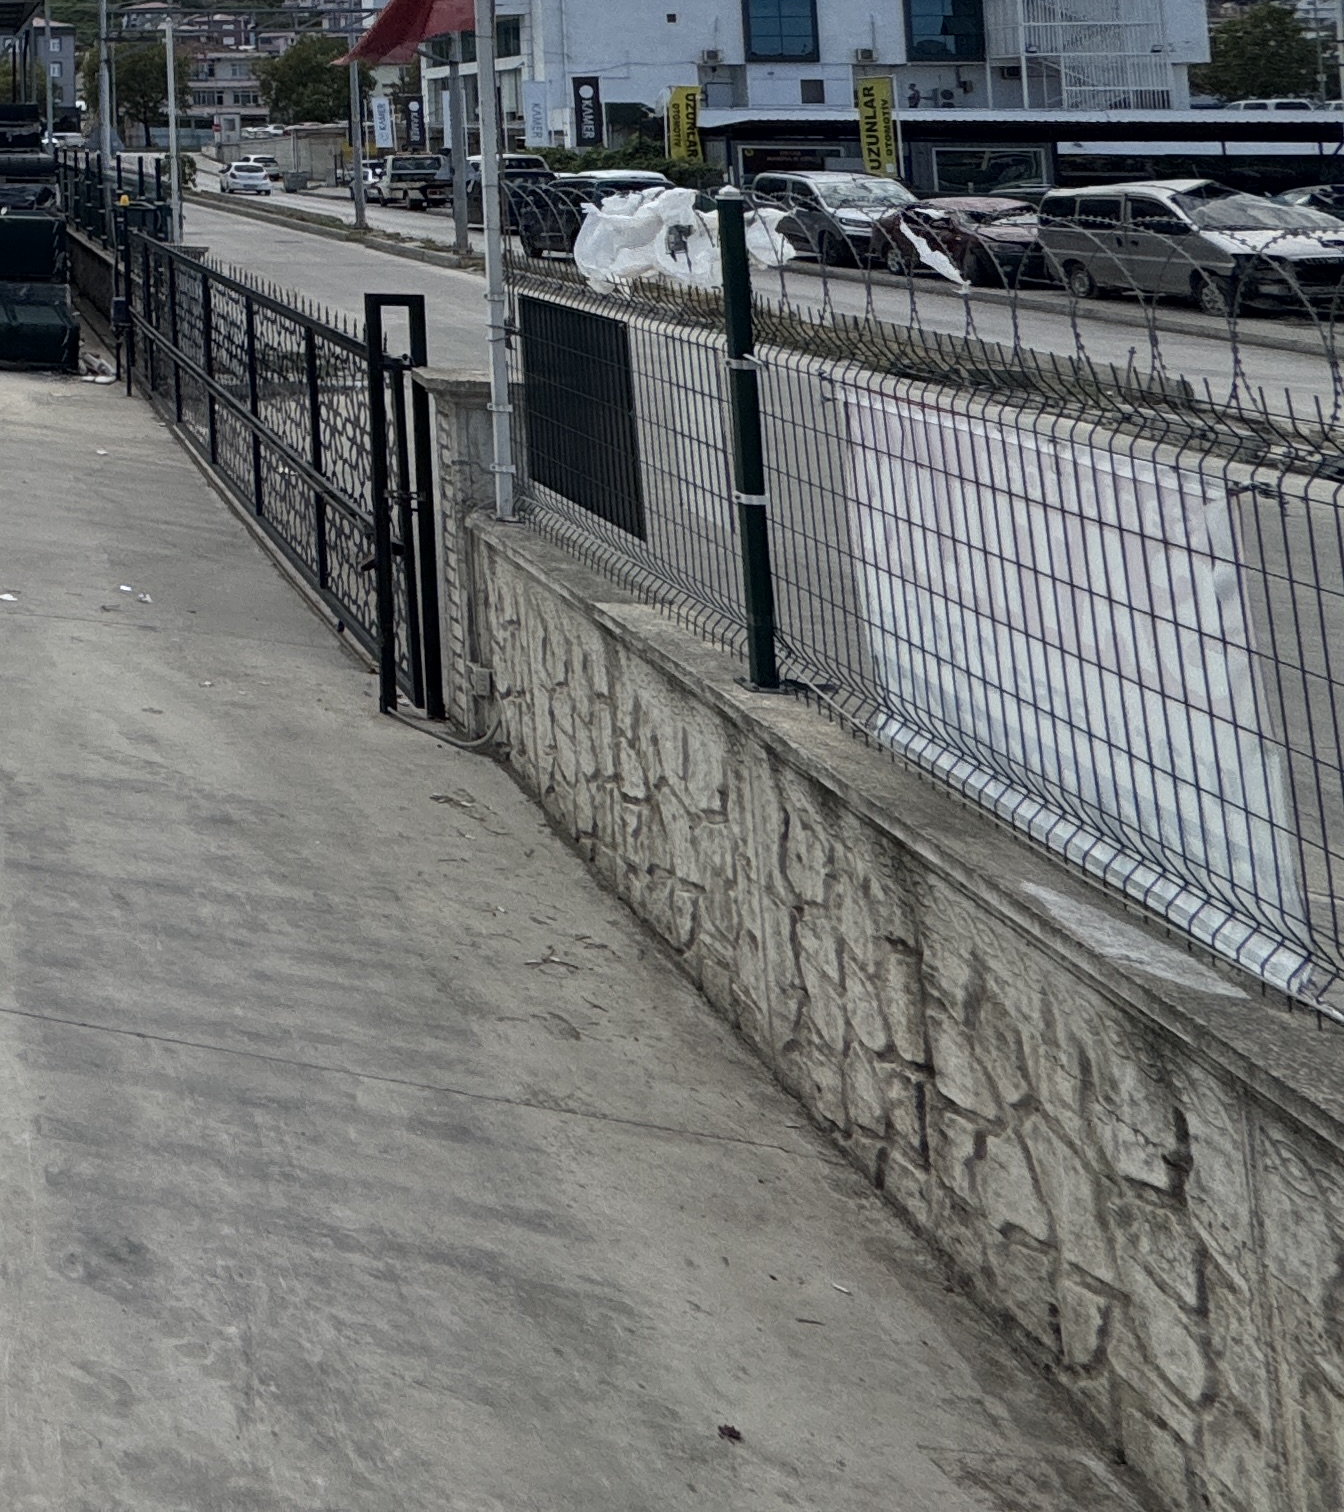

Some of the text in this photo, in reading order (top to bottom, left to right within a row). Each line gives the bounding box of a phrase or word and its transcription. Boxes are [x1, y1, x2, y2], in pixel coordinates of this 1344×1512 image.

[376, 103, 388, 131] KAMER
[410, 112, 421, 142] KAMER
[530, 103, 544, 139] KAMER
[581, 99, 596, 140] KAMER
[685, 92, 699, 158] UZUNLAR
[862, 85, 882, 171] UZUNLAR
